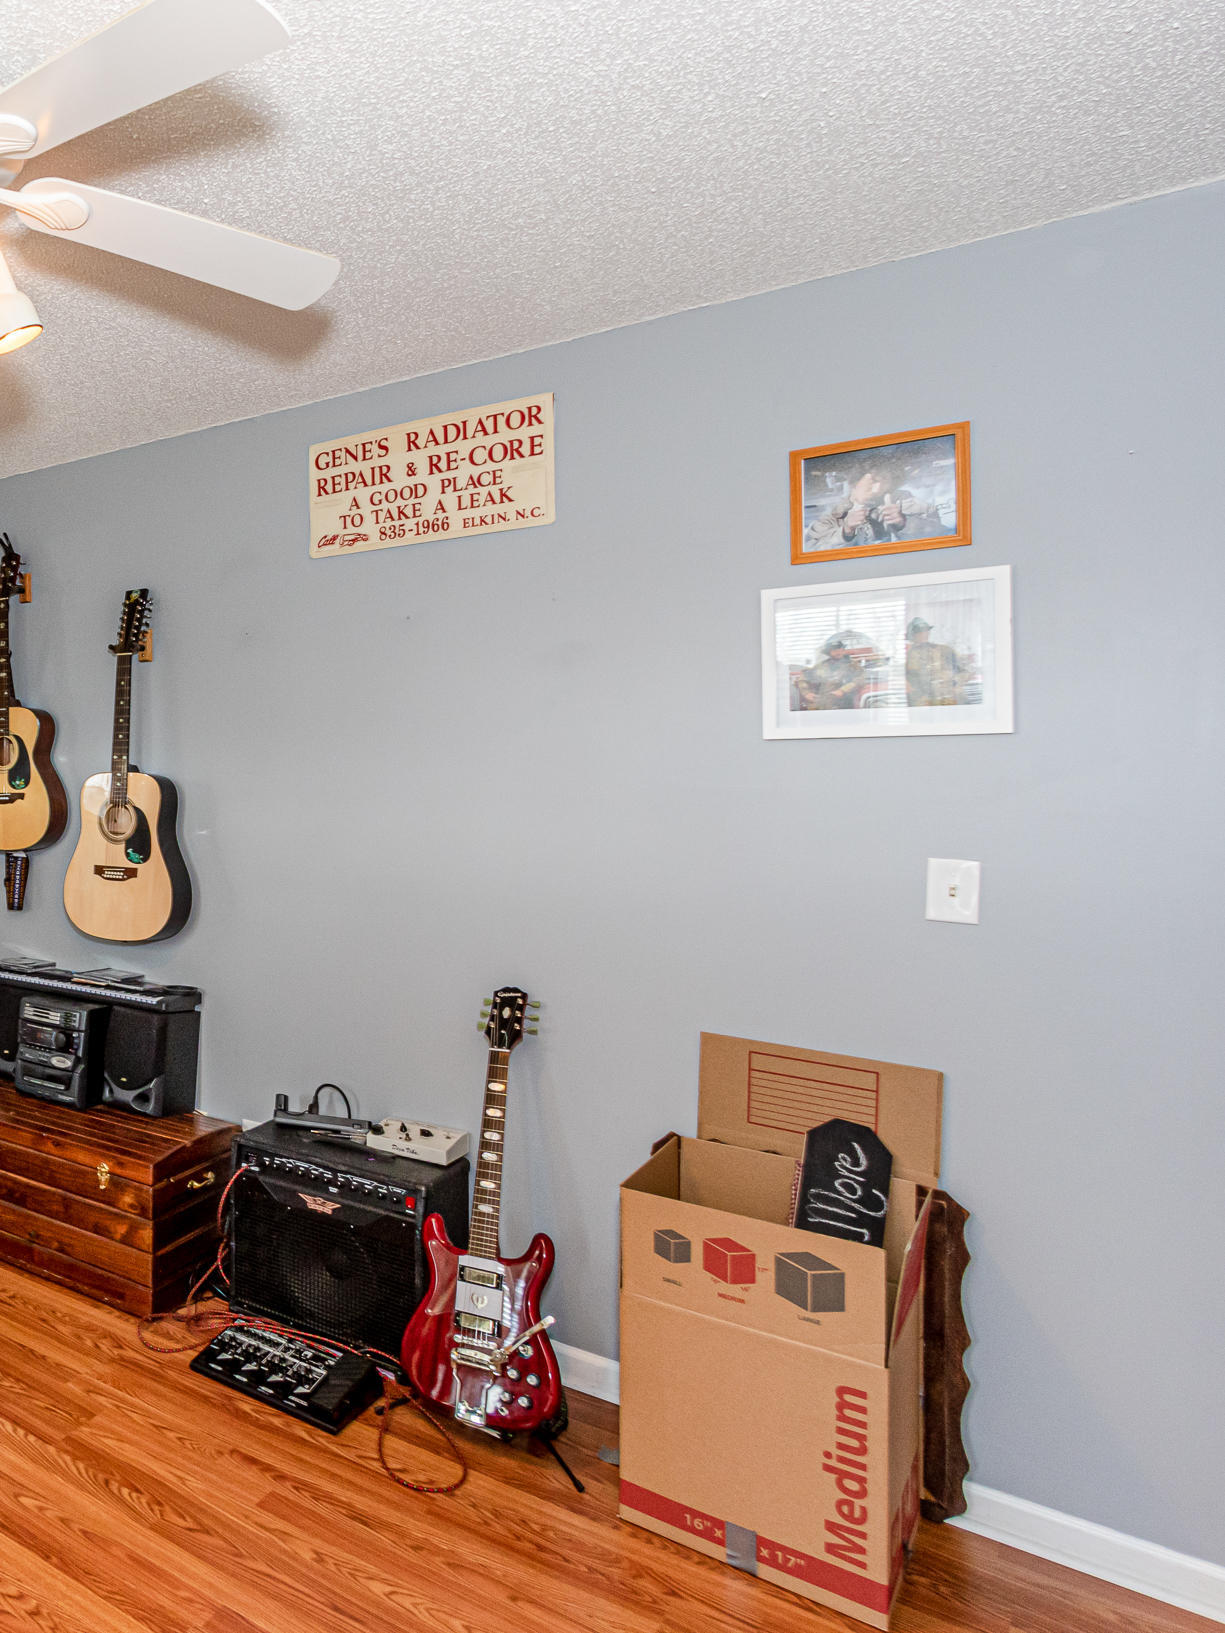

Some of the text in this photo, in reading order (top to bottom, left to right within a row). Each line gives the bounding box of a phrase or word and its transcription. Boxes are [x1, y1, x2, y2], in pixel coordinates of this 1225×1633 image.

[314, 404, 544, 472] GENE'S RADIATOR
[316, 434, 544, 497] REPAIR & RE-CORE
[339, 485, 514, 530] TO TAKE A LEAK
[348, 468, 504, 511] A GOOD PLACE
[317, 532, 338, 548] Call
[379, 516, 450, 542] 835-1966
[515, 506, 546, 521] N.C.
[807, 1142, 890, 1244] More
[717, 1292, 746, 1305] MEDIUM
[823, 1385, 869, 1572] Medium
[683, 1513, 807, 1569] 16" x x 17"
